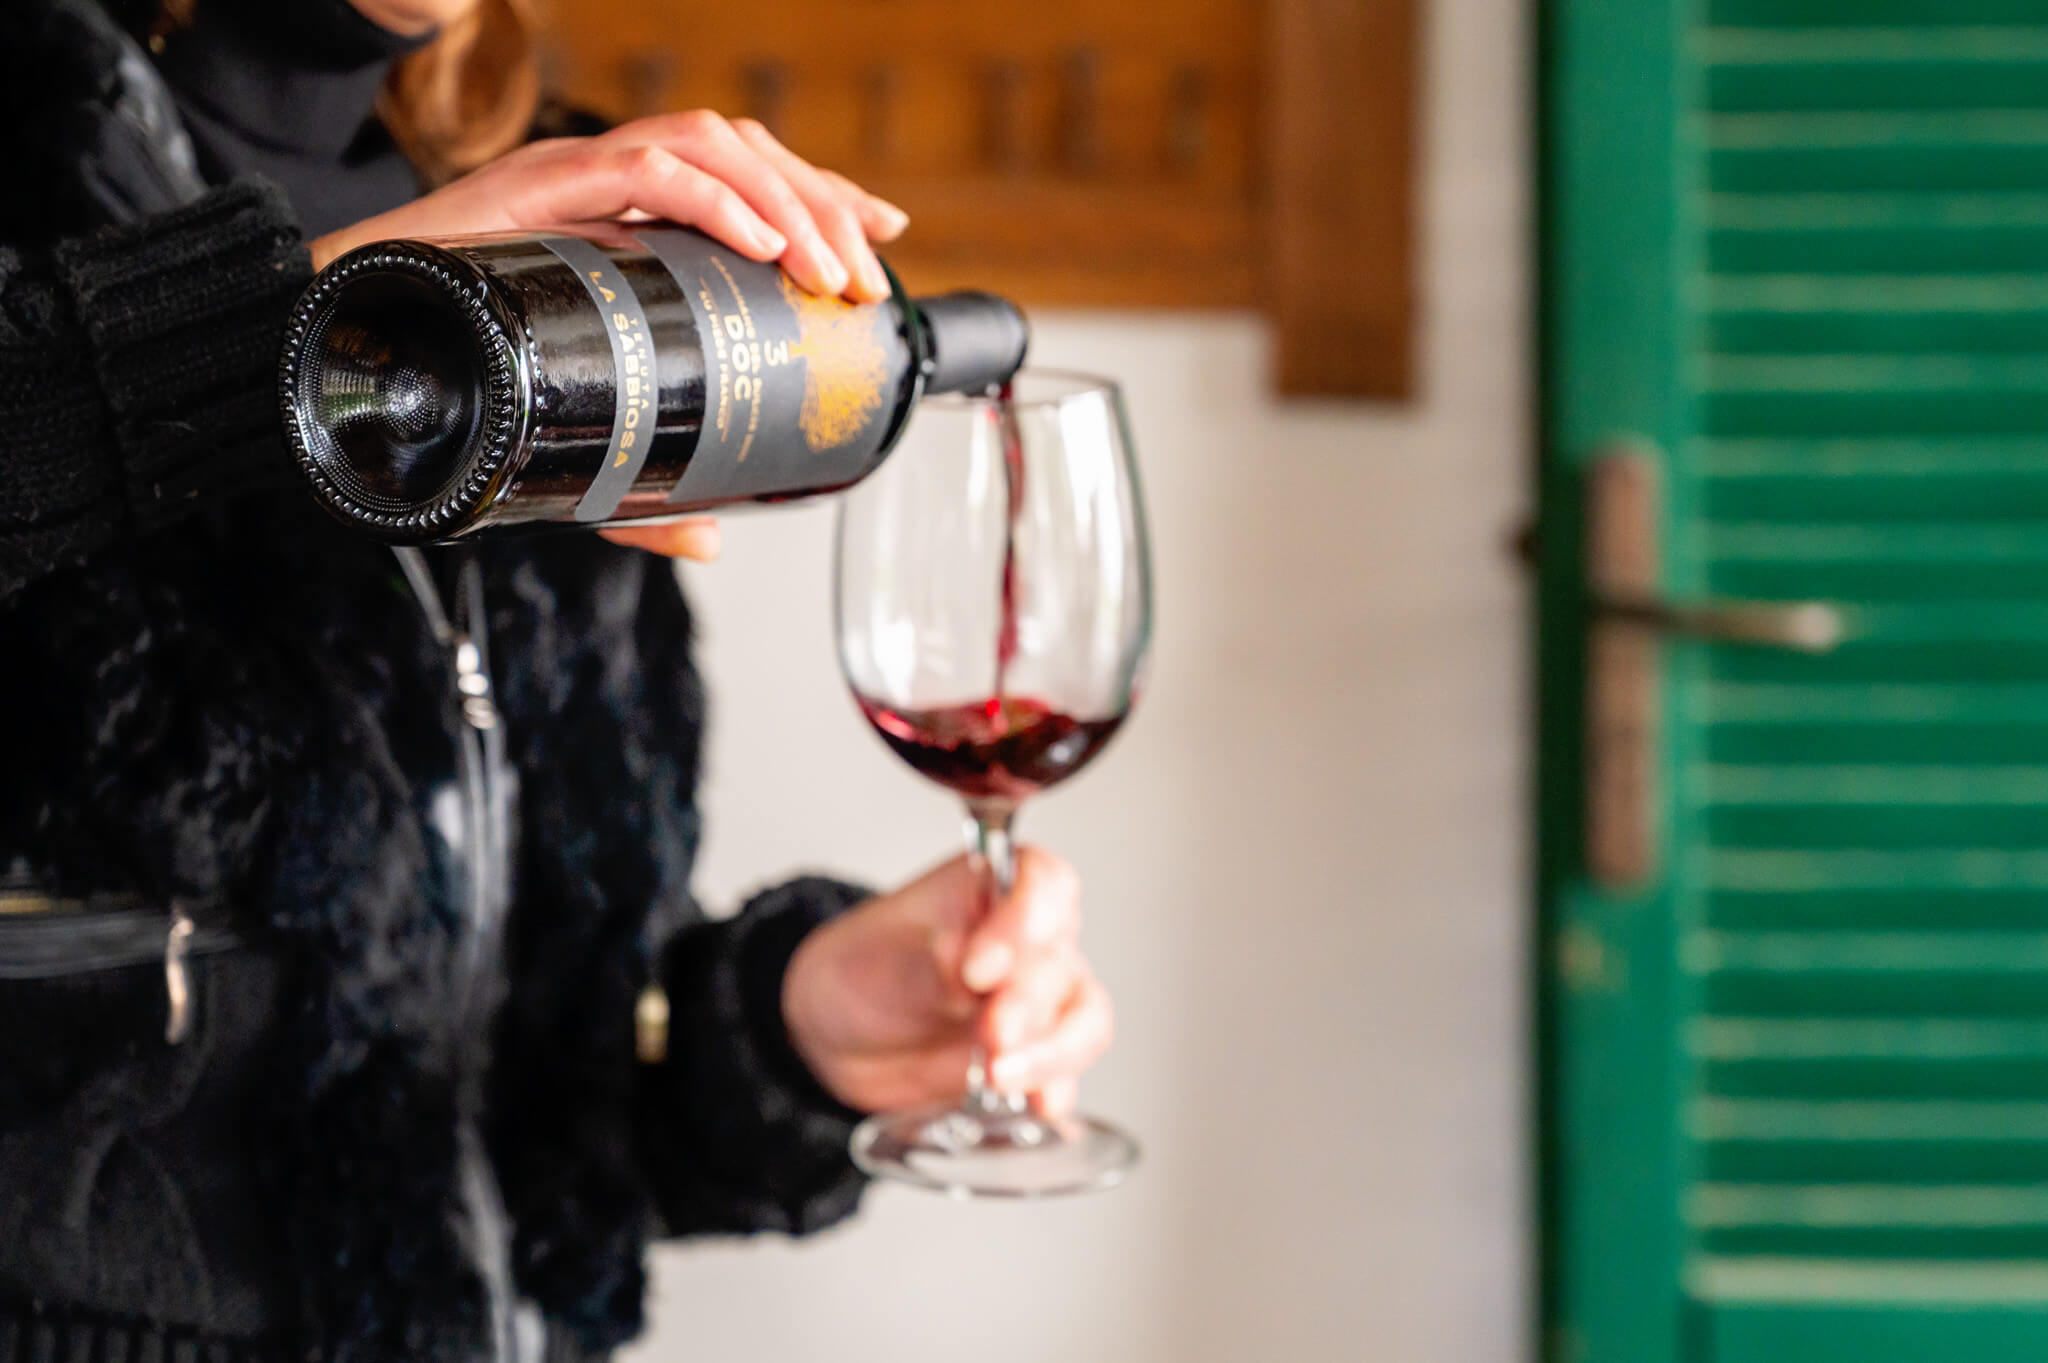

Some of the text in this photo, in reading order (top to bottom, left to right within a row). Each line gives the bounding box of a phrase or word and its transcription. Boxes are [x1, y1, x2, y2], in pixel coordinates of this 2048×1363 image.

[589, 271, 640, 468] LA SABBIOSA
[629, 318, 650, 409] TENUTA
[723, 314, 752, 400] DOC
[764, 340, 788, 367] 3
